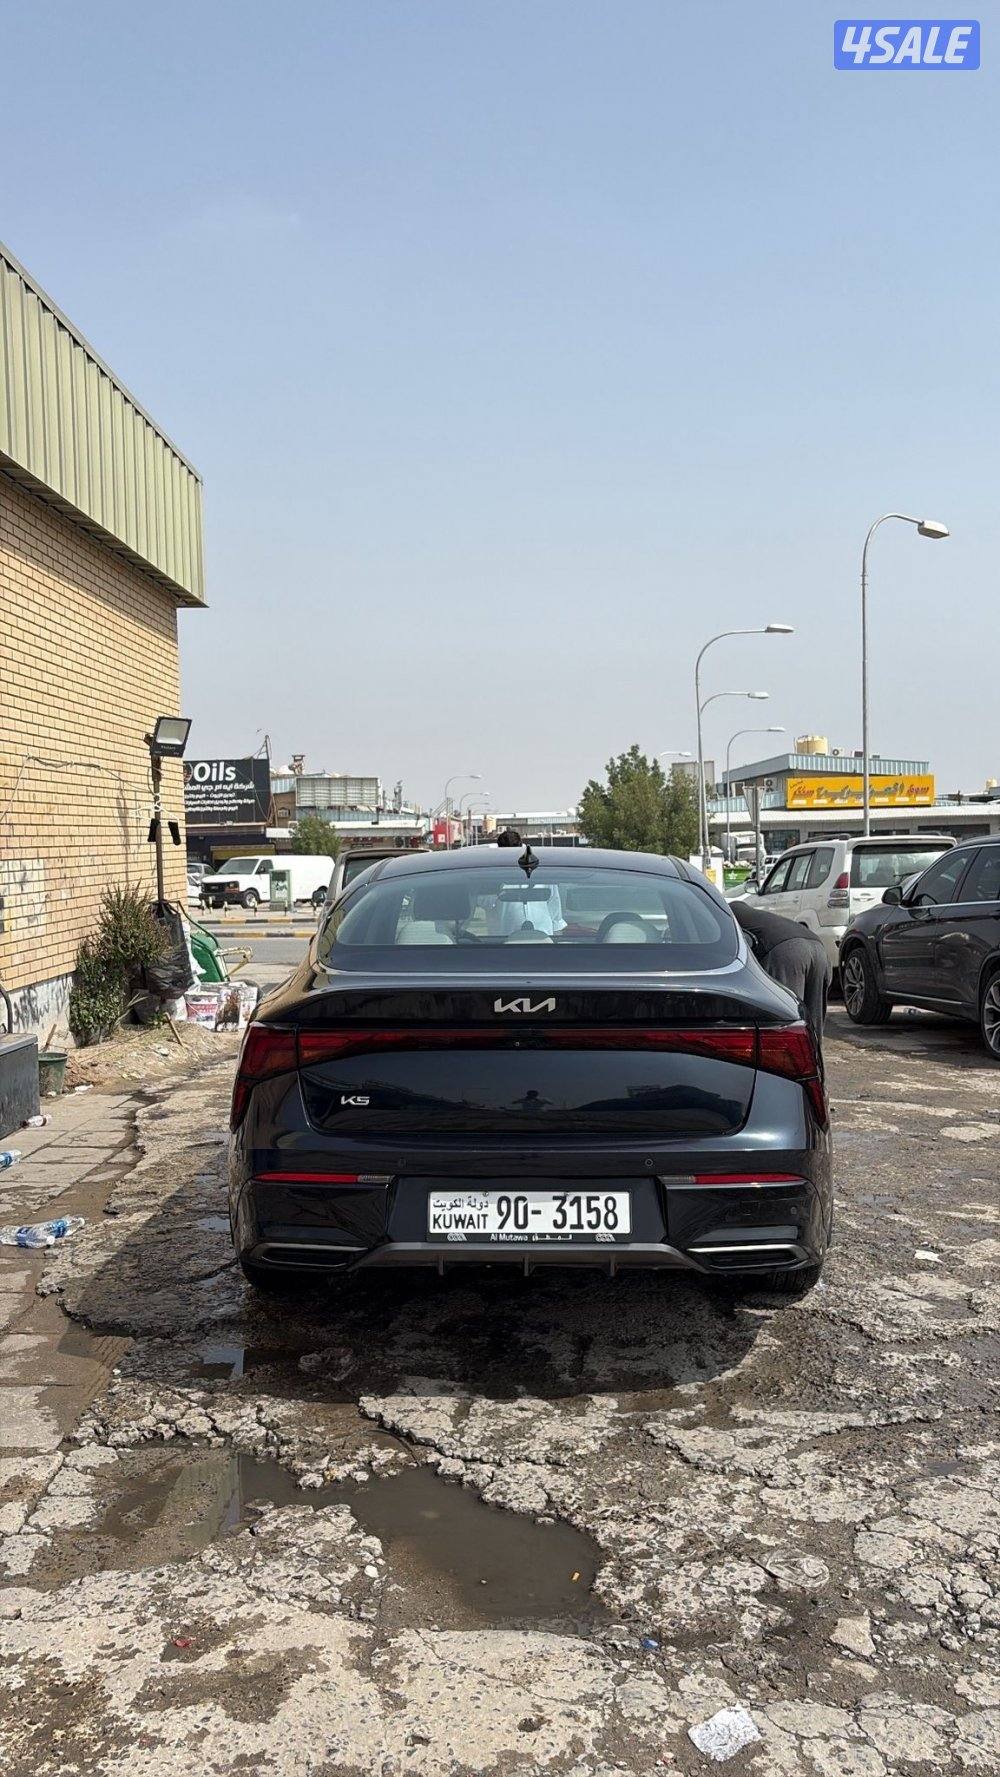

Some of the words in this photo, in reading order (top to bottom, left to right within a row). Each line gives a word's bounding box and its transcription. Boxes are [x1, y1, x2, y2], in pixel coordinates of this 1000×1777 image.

[193, 761, 236, 782] Oils
[494, 997, 556, 1013] KIA
[340, 1095, 370, 1105] K5
[433, 1197, 464, 1212] الكويت
[467, 1195, 489, 1211] دولة
[552, 1195, 619, 1230] 3158
[432, 1213, 489, 1230] KUWAIT
